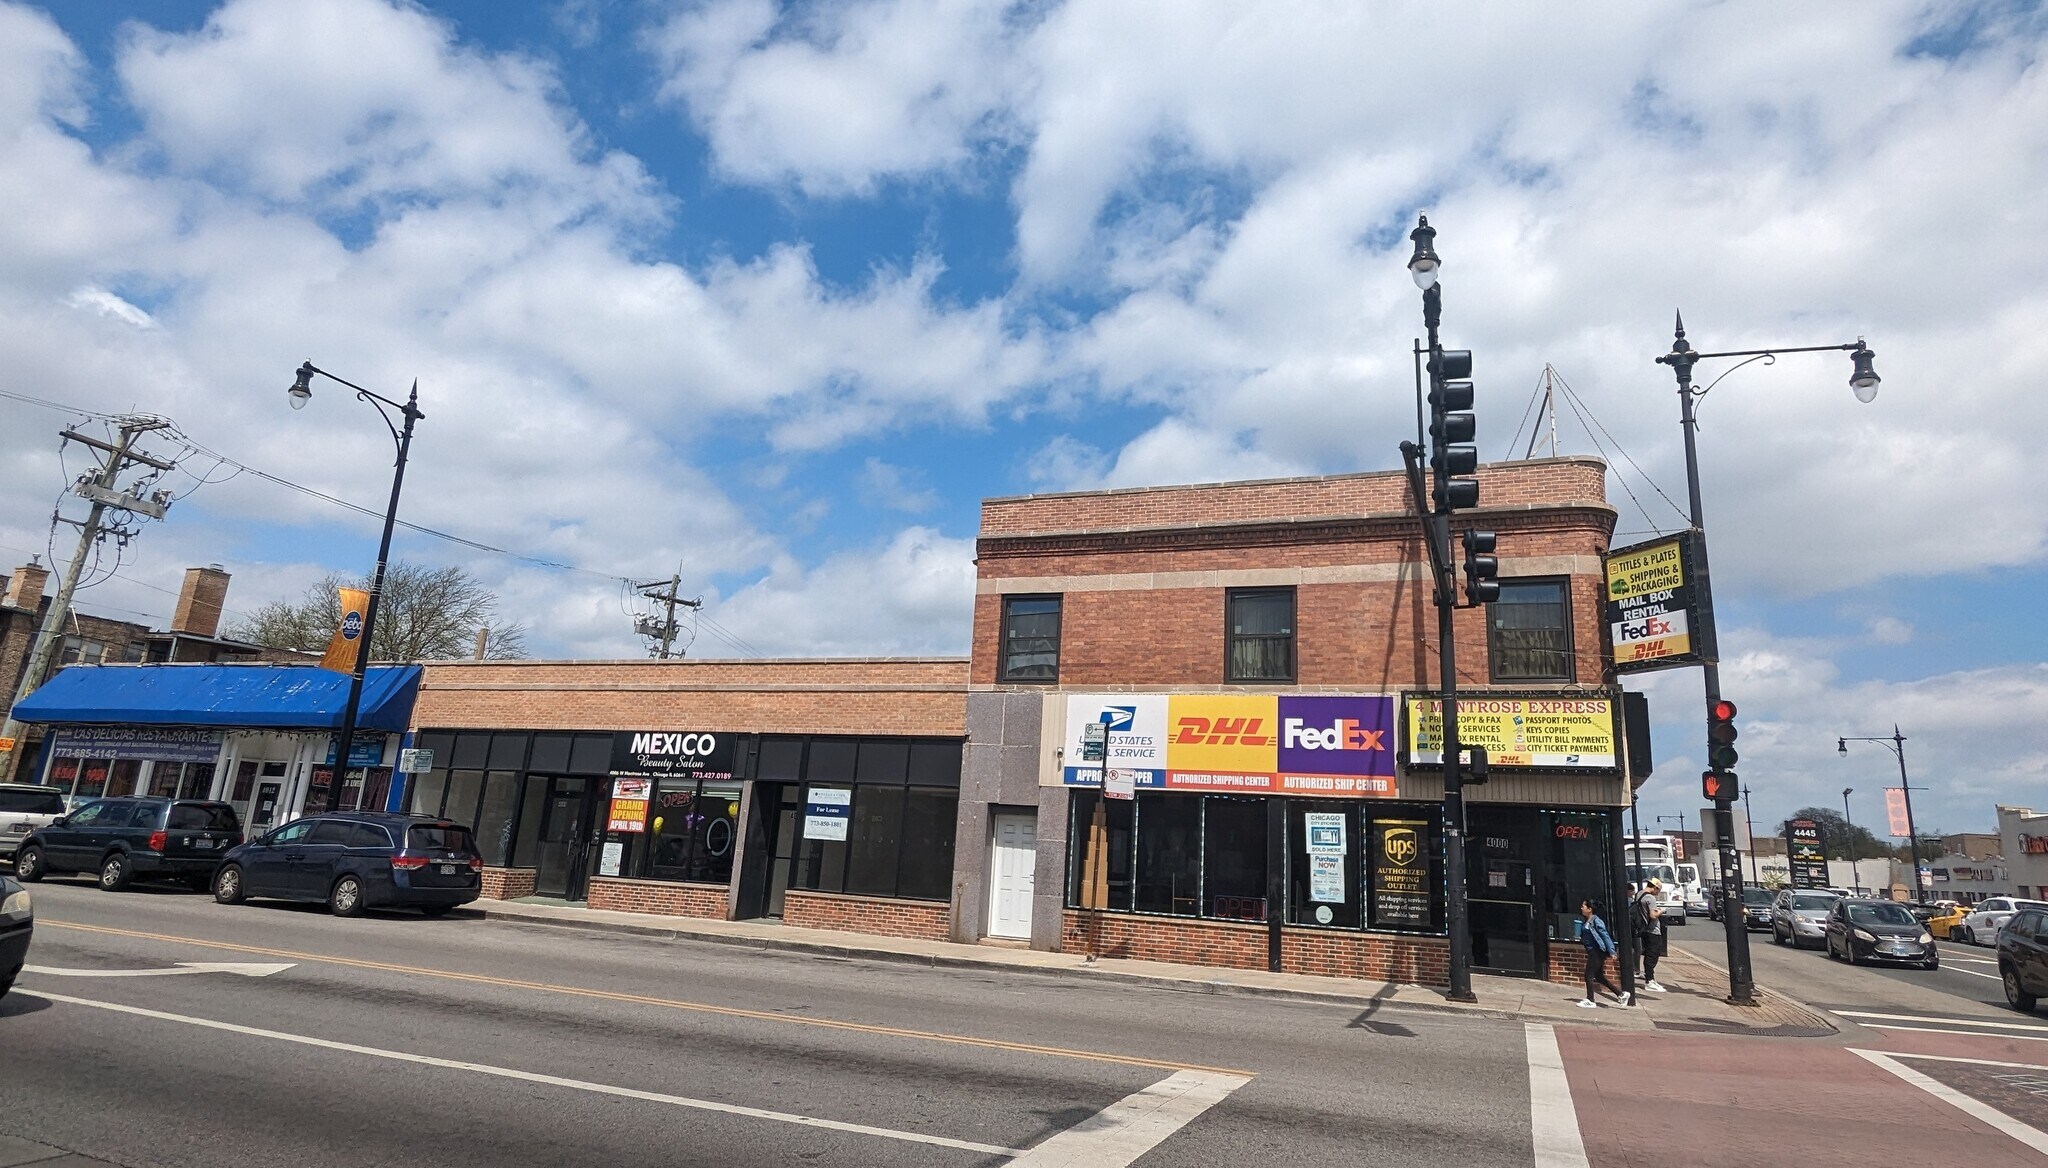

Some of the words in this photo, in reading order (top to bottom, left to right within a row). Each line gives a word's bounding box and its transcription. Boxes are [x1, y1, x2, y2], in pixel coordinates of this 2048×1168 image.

[1619, 558, 1641, 572] TITLES
[1643, 557, 1649, 566] &
[1651, 549, 1677, 564] PLATES
[1630, 566, 1670, 583] SHIPPING
[1672, 564, 1679, 573] &
[1631, 575, 1679, 594] PACKAGING
[1619, 595, 1646, 609] MAIL
[1650, 589, 1674, 601] BOX
[1624, 603, 1668, 620] RENTAL
[1621, 617, 1671, 641] FedEx
[1635, 640, 1667, 659] DHL
[1415, 701, 1424, 712] 4
[1430, 701, 1522, 713] MNTROSE
[1528, 701, 1607, 714] EXPRESS
[1526, 716, 1560, 724] PASSPORT
[1174, 717, 1270, 746] DHL
[1284, 718, 1385, 751] FedEx
[630, 733, 716, 756] MEXICO
[1118, 736, 1153, 745] STATES
[55, 748, 117, 758] 773-685-4142
[1114, 749, 1155, 757] SERVICE
[637, 754, 673, 771] Beauty
[676, 755, 705, 768] Salon
[692, 771, 731, 780] 773.427.0189
[1172, 774, 1211, 785] AUTHORIZED
[1213, 775, 1243, 786] SHIPPING
[1245, 776, 1269, 787] CENTER
[1284, 777, 1333, 790] AUTHORIZED
[1335, 779, 1354, 790] SHIP
[1355, 779, 1387, 791] CENTER
[616, 800, 644, 810] GRAND
[662, 791, 690, 807] OPEN
[612, 810, 644, 820] OPENING
[609, 820, 628, 830] APRIL
[629, 821, 643, 831] 19th
[1556, 826, 1589, 838] OPEN
[1794, 829, 1816, 837] 4445
[1387, 840, 1415, 859] ups
[1488, 838, 1507, 848] 4000
[1377, 867, 1426, 876] AUTHORIZED
[1384, 875, 1420, 883] SHIPPING
[1216, 898, 1265, 919] OPEN
